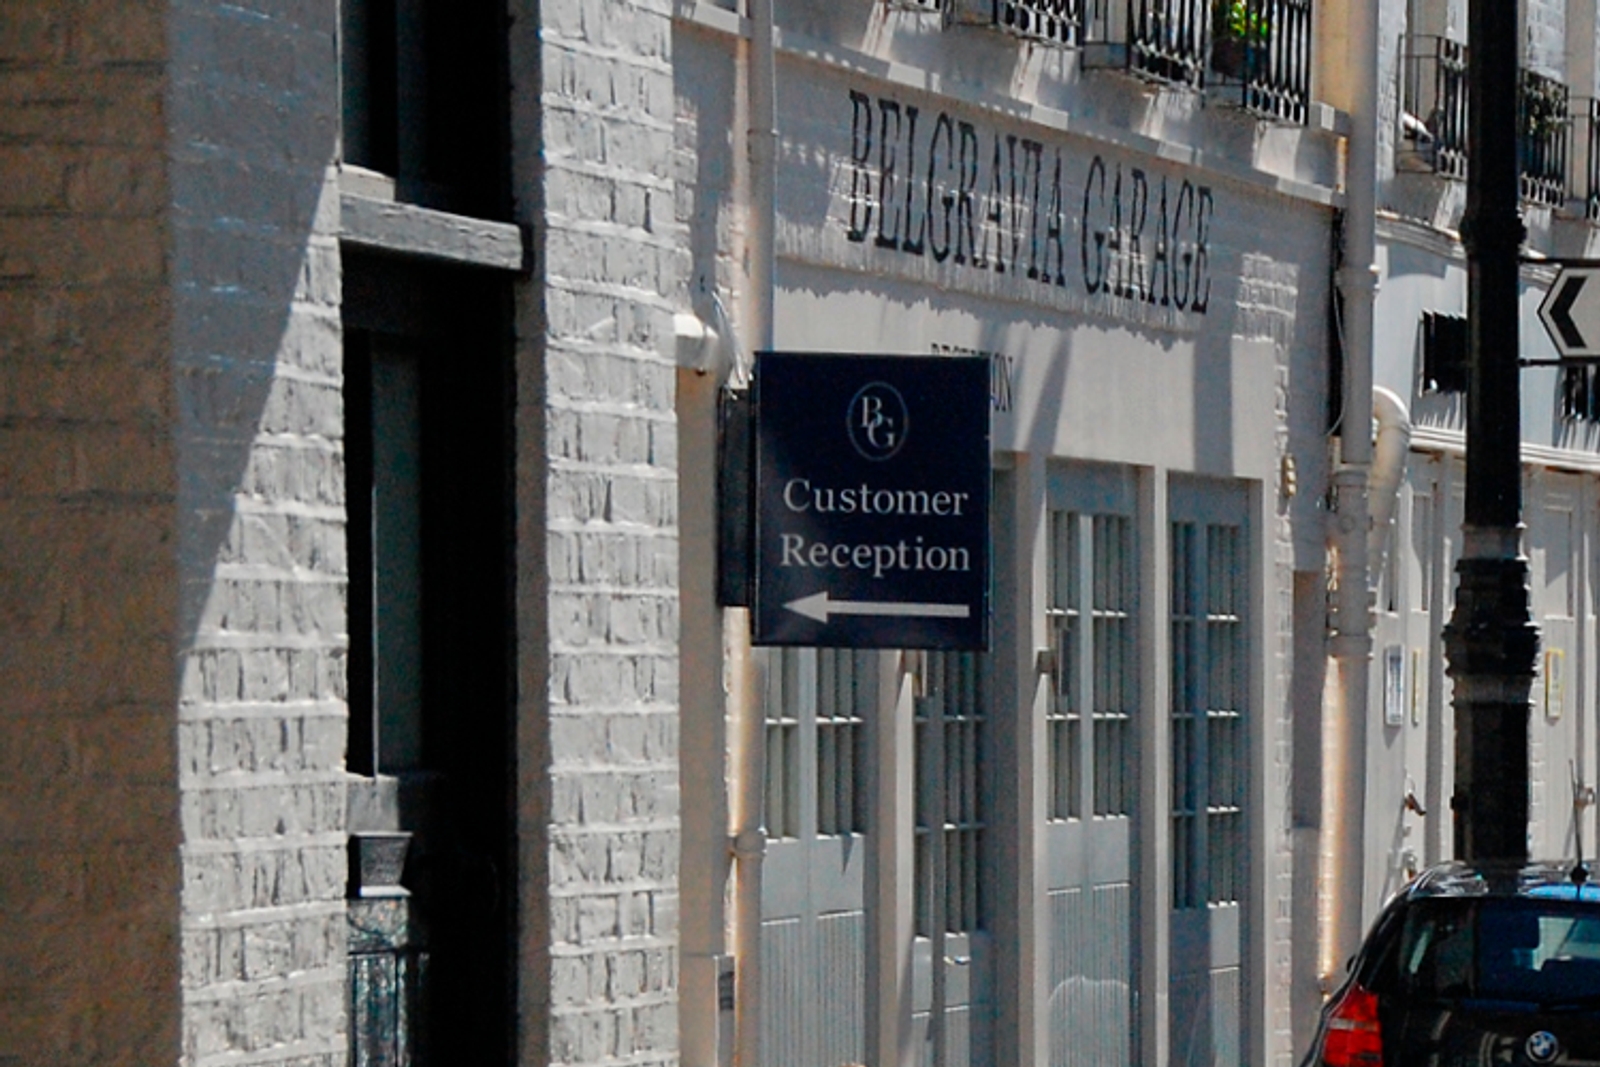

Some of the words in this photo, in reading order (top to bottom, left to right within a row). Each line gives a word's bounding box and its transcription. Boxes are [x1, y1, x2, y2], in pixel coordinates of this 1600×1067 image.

[847, 89, 1066, 287] BELGRAVIA
[1081, 154, 1214, 315] GARAGE
[782, 477, 969, 516] Customer
[780, 533, 971, 579] Reception
